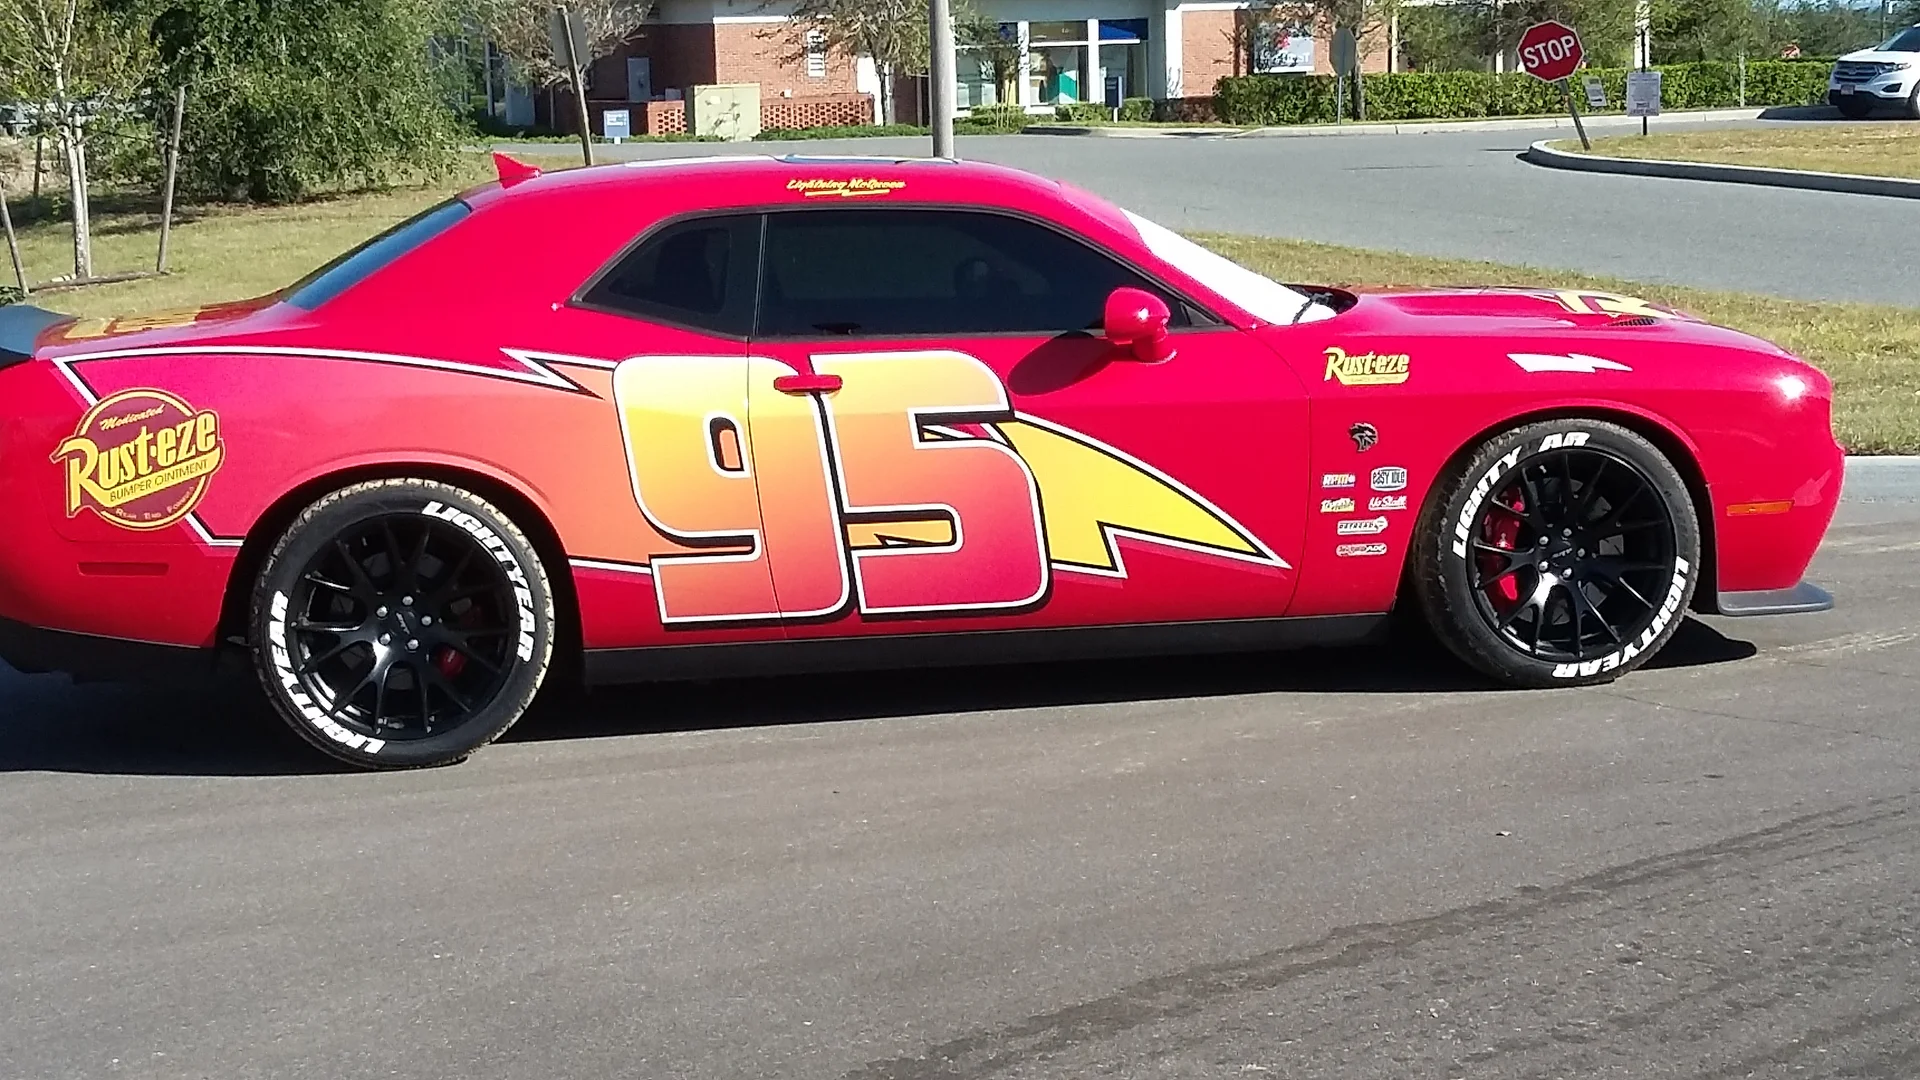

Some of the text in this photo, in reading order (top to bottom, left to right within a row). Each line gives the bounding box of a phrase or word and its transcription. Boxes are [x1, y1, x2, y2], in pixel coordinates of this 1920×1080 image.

[1524, 35, 1575, 69] STOP
[99, 403, 166, 431] Medicated
[109, 458, 209, 503] BUMPER OINTMENT
[612, 352, 1052, 624] 95
[421, 500, 536, 664] LIGHTYEAR
[1552, 556, 1690, 678] LIGHTYEAR
[269, 590, 386, 754] LIGHTYEAR
